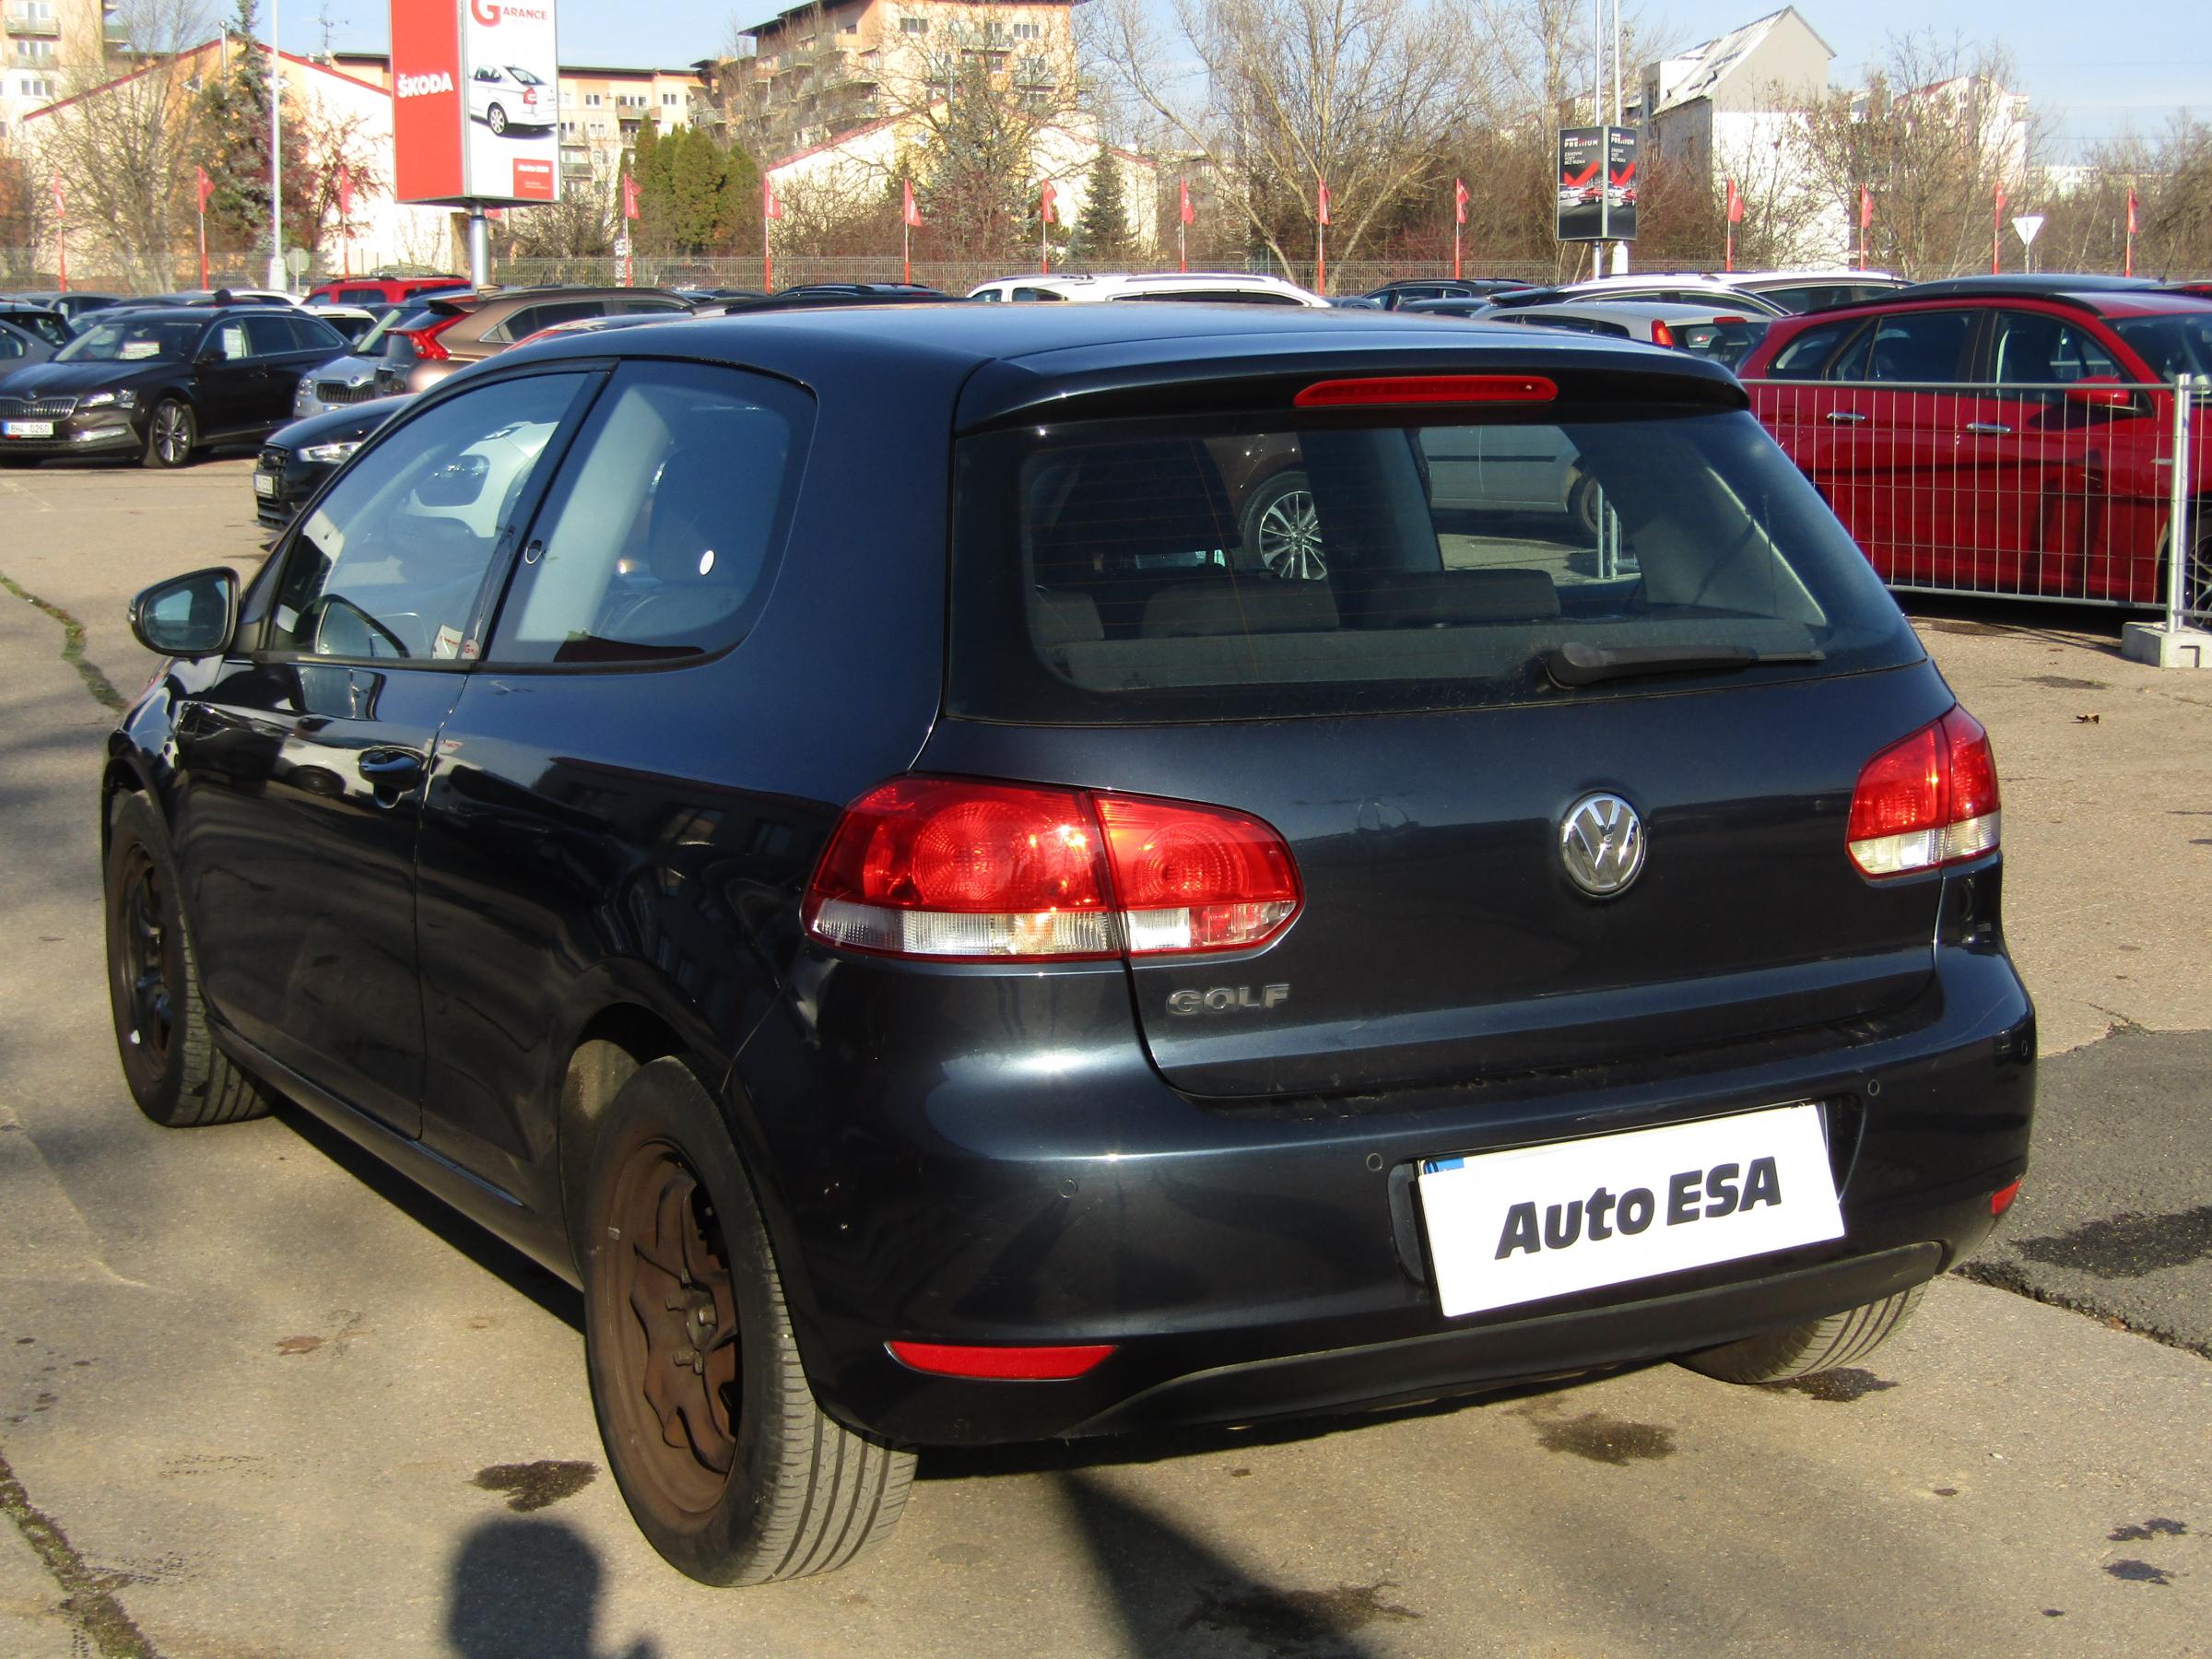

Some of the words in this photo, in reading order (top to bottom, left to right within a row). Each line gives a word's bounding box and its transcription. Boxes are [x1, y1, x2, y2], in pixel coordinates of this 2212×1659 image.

[471, 0, 547, 27] GARANCE
[397, 73, 454, 99] ŠKODA
[1166, 983, 1290, 1016] GOLF
[1494, 1186, 1655, 1260] Auto
[1666, 1156, 1782, 1227] ESA
